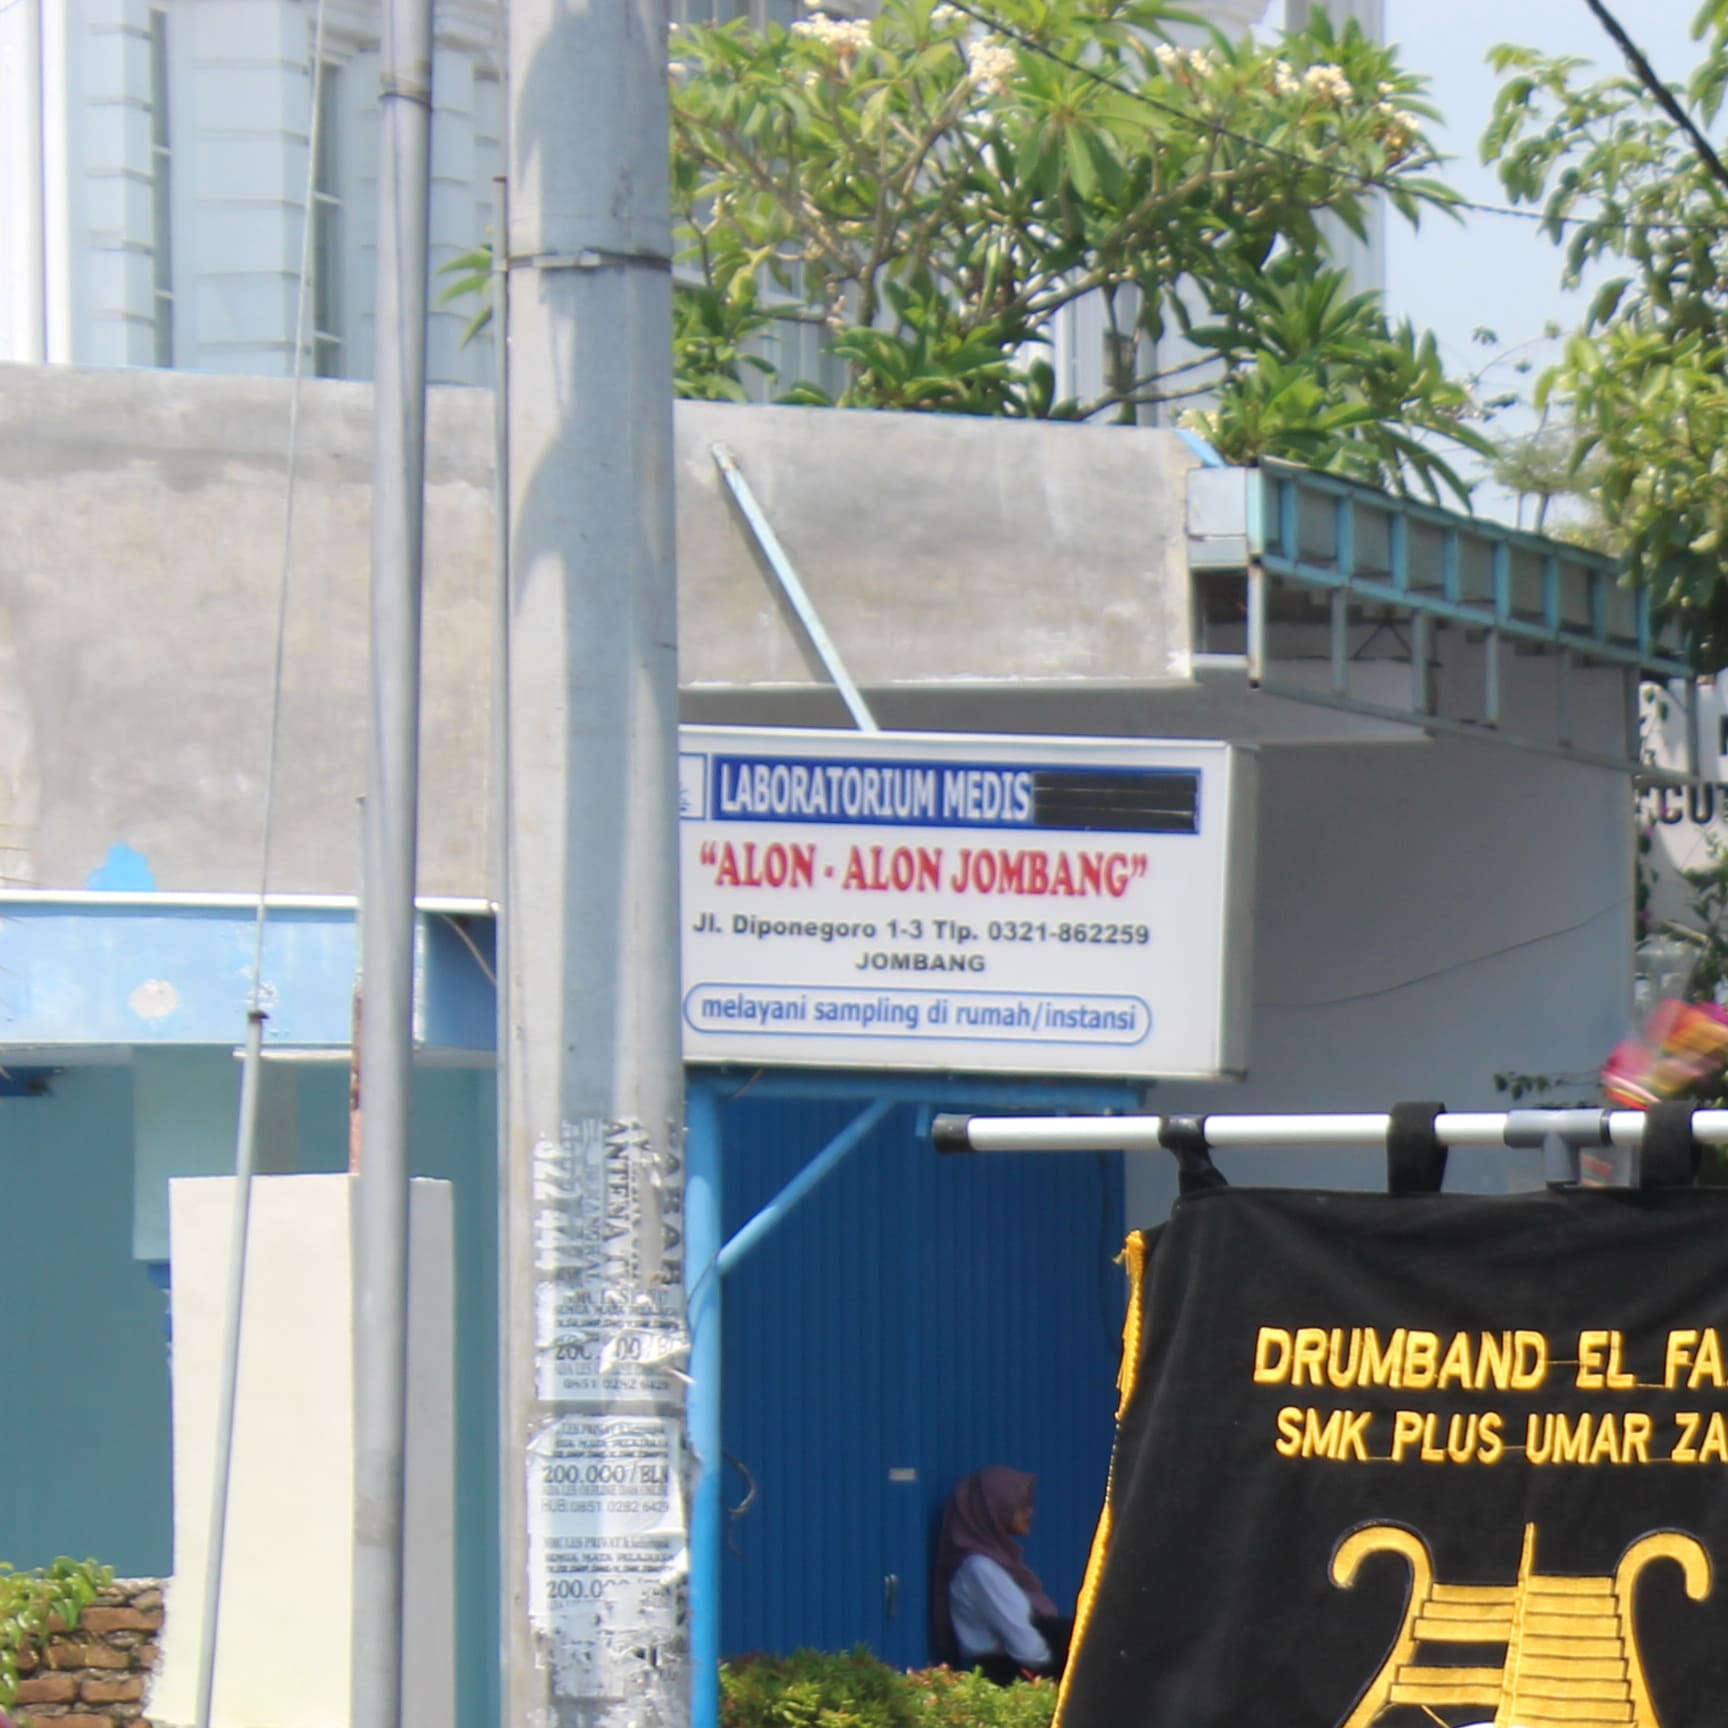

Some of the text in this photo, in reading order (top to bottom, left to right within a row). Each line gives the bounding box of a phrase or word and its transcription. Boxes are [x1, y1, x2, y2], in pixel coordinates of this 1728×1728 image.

[720, 763, 937, 818] LABORATORIUM
[943, 770, 1033, 822] MEDIS
[843, 845, 943, 893] ALON
[693, 911, 1150, 945] Jl. Diponegoro 1-3 Tlp. 0321-862259
[855, 952, 986, 973] JOMBANG
[701, 993, 1137, 1033] melayani sampling di rumah/instansi
[1253, 1326, 1548, 1390] DRUMBAND
[1575, 1329, 1636, 1389] EL
[1274, 1406, 1373, 1462] SMK
[1390, 1410, 1504, 1465] PLUS
[1524, 1411, 1654, 1464] UMAR
